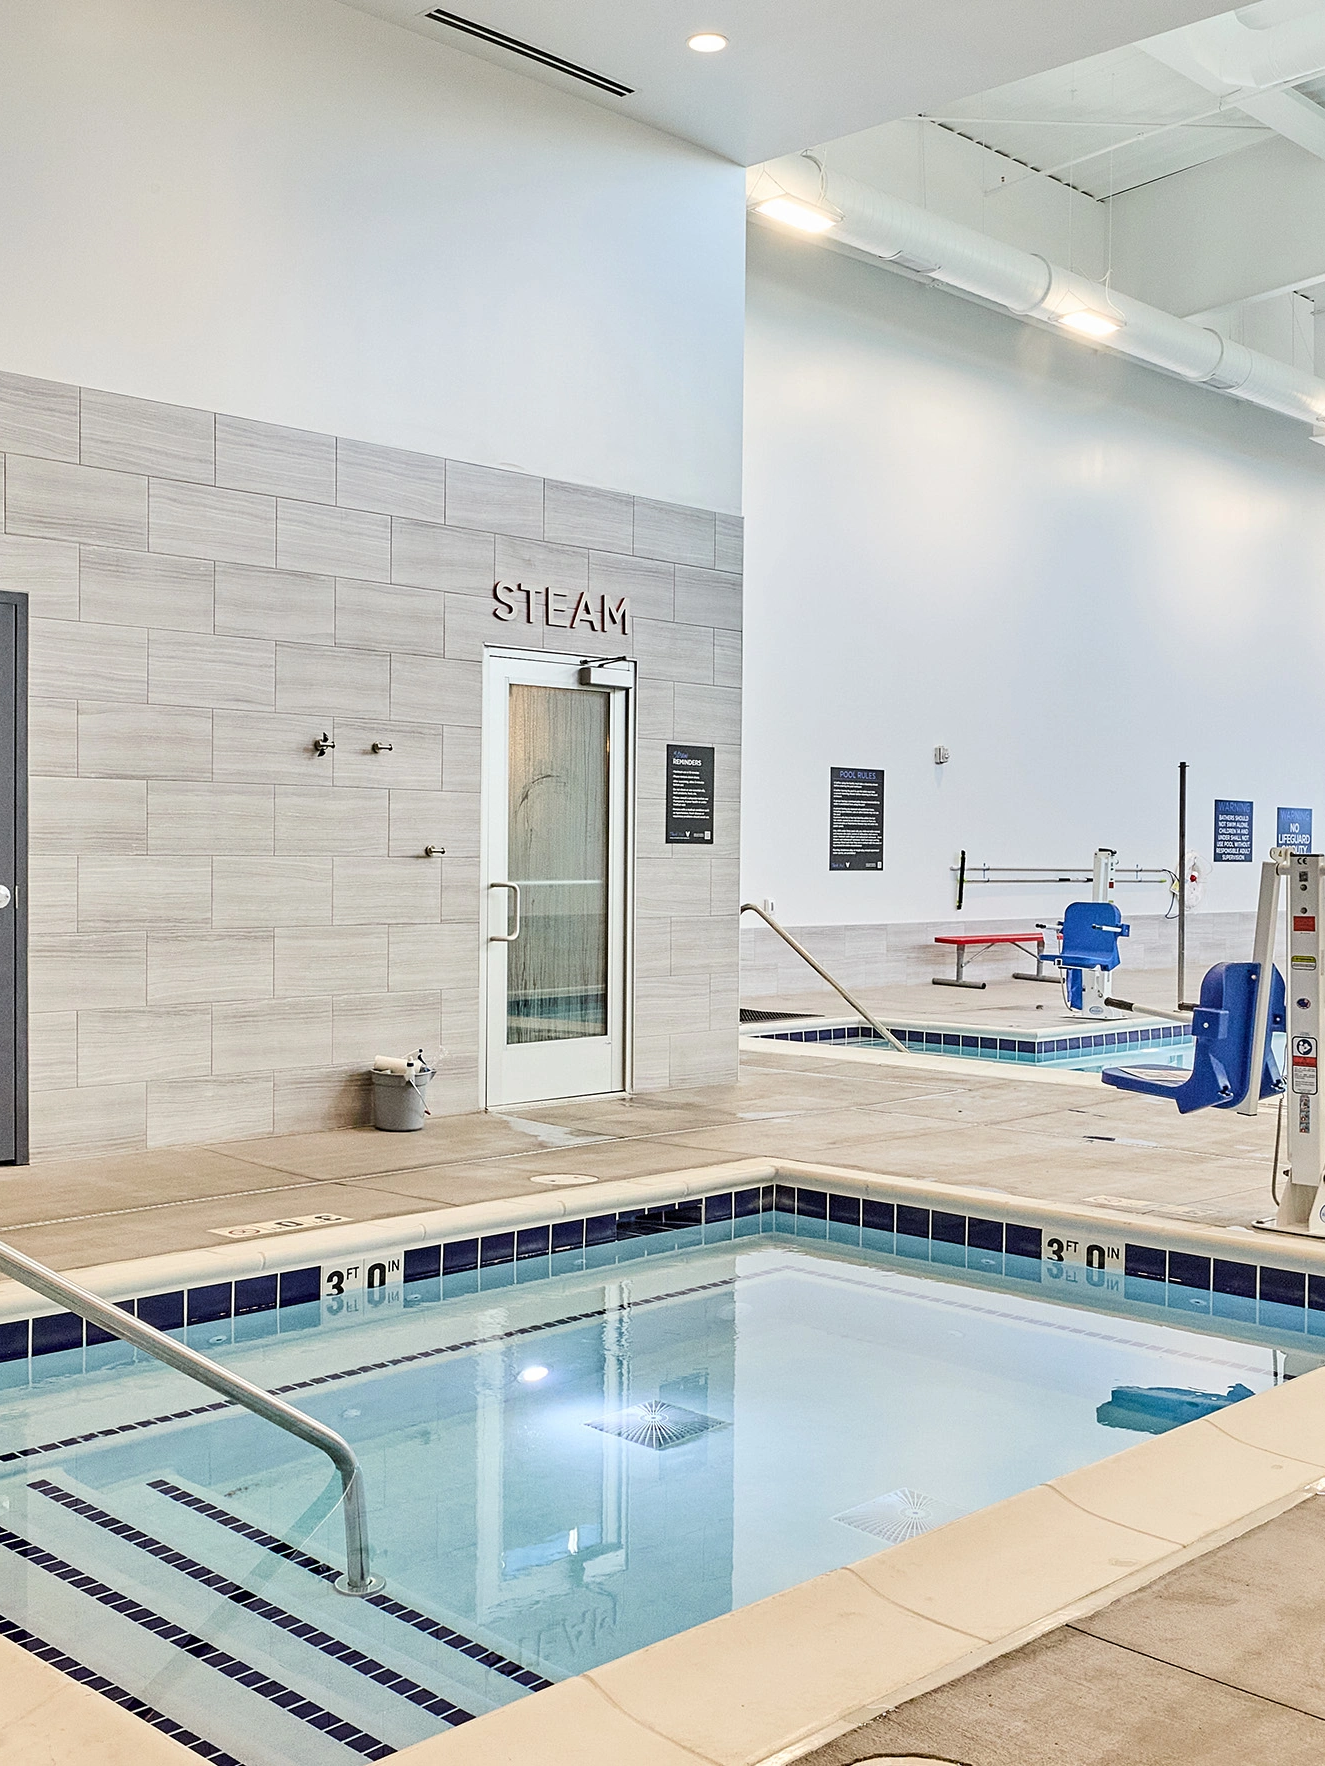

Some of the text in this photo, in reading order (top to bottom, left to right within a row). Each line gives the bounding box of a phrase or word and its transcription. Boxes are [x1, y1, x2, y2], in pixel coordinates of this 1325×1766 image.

[493, 580, 630, 635] STEAM
[840, 771, 876, 780] POOL RULES
[1218, 802, 1250, 812] WARNING
[1280, 810, 1310, 820] WARNING
[1290, 823, 1299, 833] NO
[1278, 834, 1310, 844] LIFEGUARD
[1047, 1238, 1064, 1262] 3
[1066, 1240, 1079, 1253] FT
[1107, 1247, 1120, 1260] IN
[326, 1270, 344, 1296] 3
[346, 1266, 359, 1280] FT
[388, 1259, 400, 1272] IN
